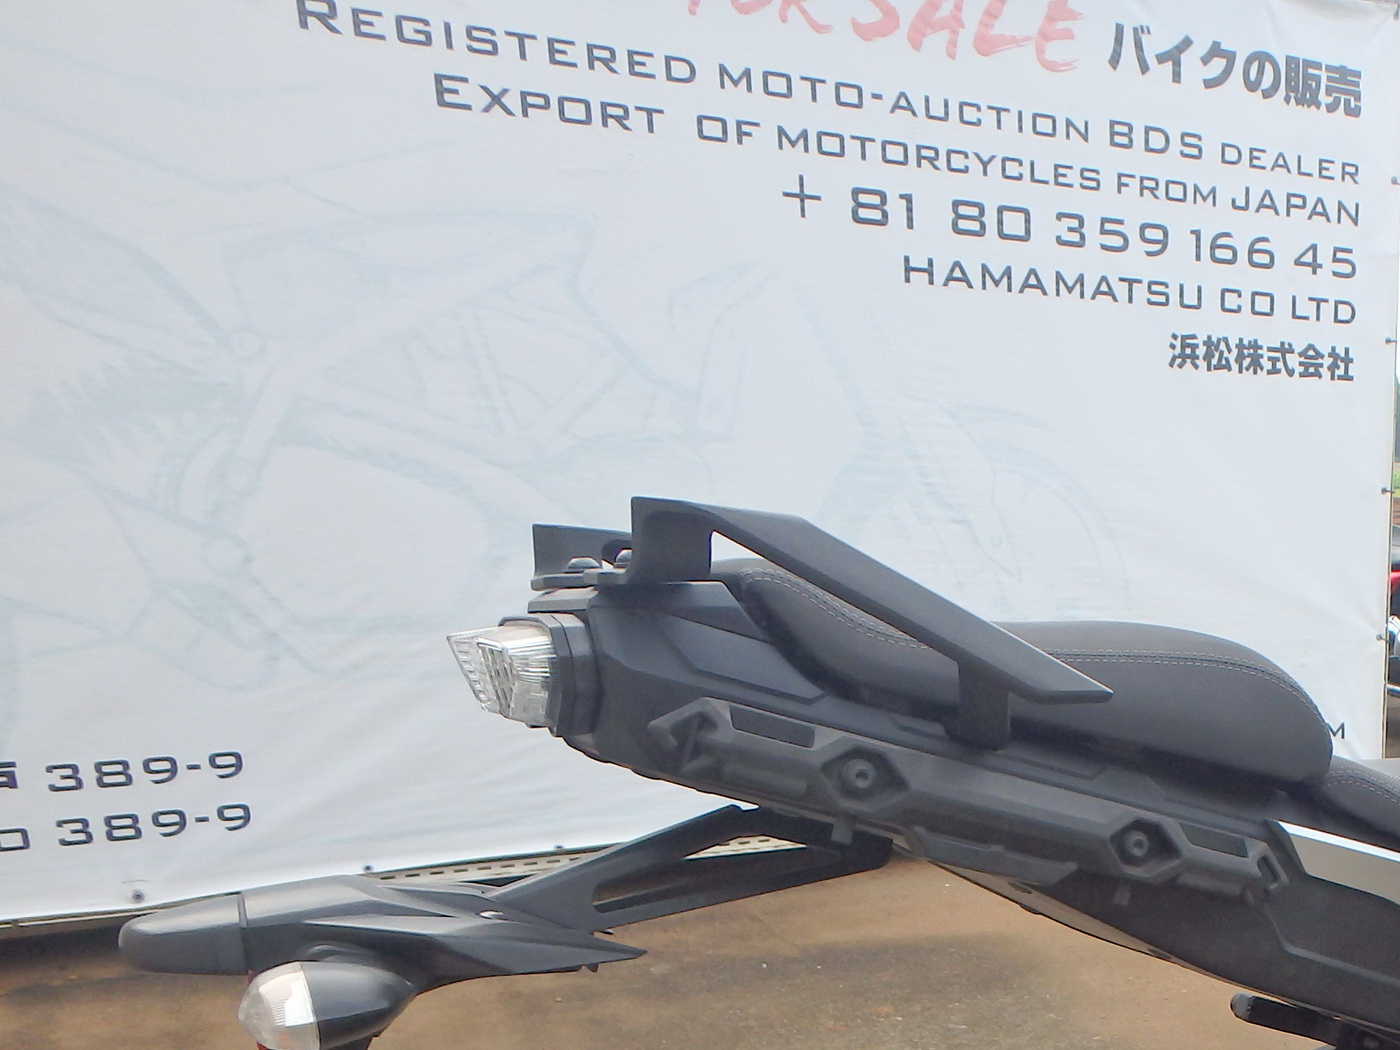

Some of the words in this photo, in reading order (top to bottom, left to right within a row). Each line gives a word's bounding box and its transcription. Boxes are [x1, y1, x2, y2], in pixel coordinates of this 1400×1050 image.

[296, 0, 697, 84] REGISTERED
[718, 63, 1089, 143] MOTO-AUCTION
[1108, 119, 1203, 160] BDS
[1220, 142, 1360, 184] DEALER
[1107, 22, 1362, 118] バイクの販売
[433, 73, 665, 134] EXPORT
[697, 114, 761, 146] OF
[776, 124, 1101, 192] MOTORCYCLES
[1116, 171, 1217, 208] FROM
[1230, 186, 1360, 227] JAPAN
[850, 187, 915, 230] 81
[951, 200, 1032, 242] 80
[1055, 212, 1169, 257] 359
[1189, 229, 1276, 270] 166
[1294, 243, 1357, 279] 45
[903, 255, 1203, 311] HAMAMATSU
[1219, 287, 1275, 318] CO
[1291, 294, 1357, 325] LTD
[1167, 332, 1355, 381] 浜松株式会社
[45, 751, 244, 792] 389-9
[55, 803, 252, 846] 389-9
